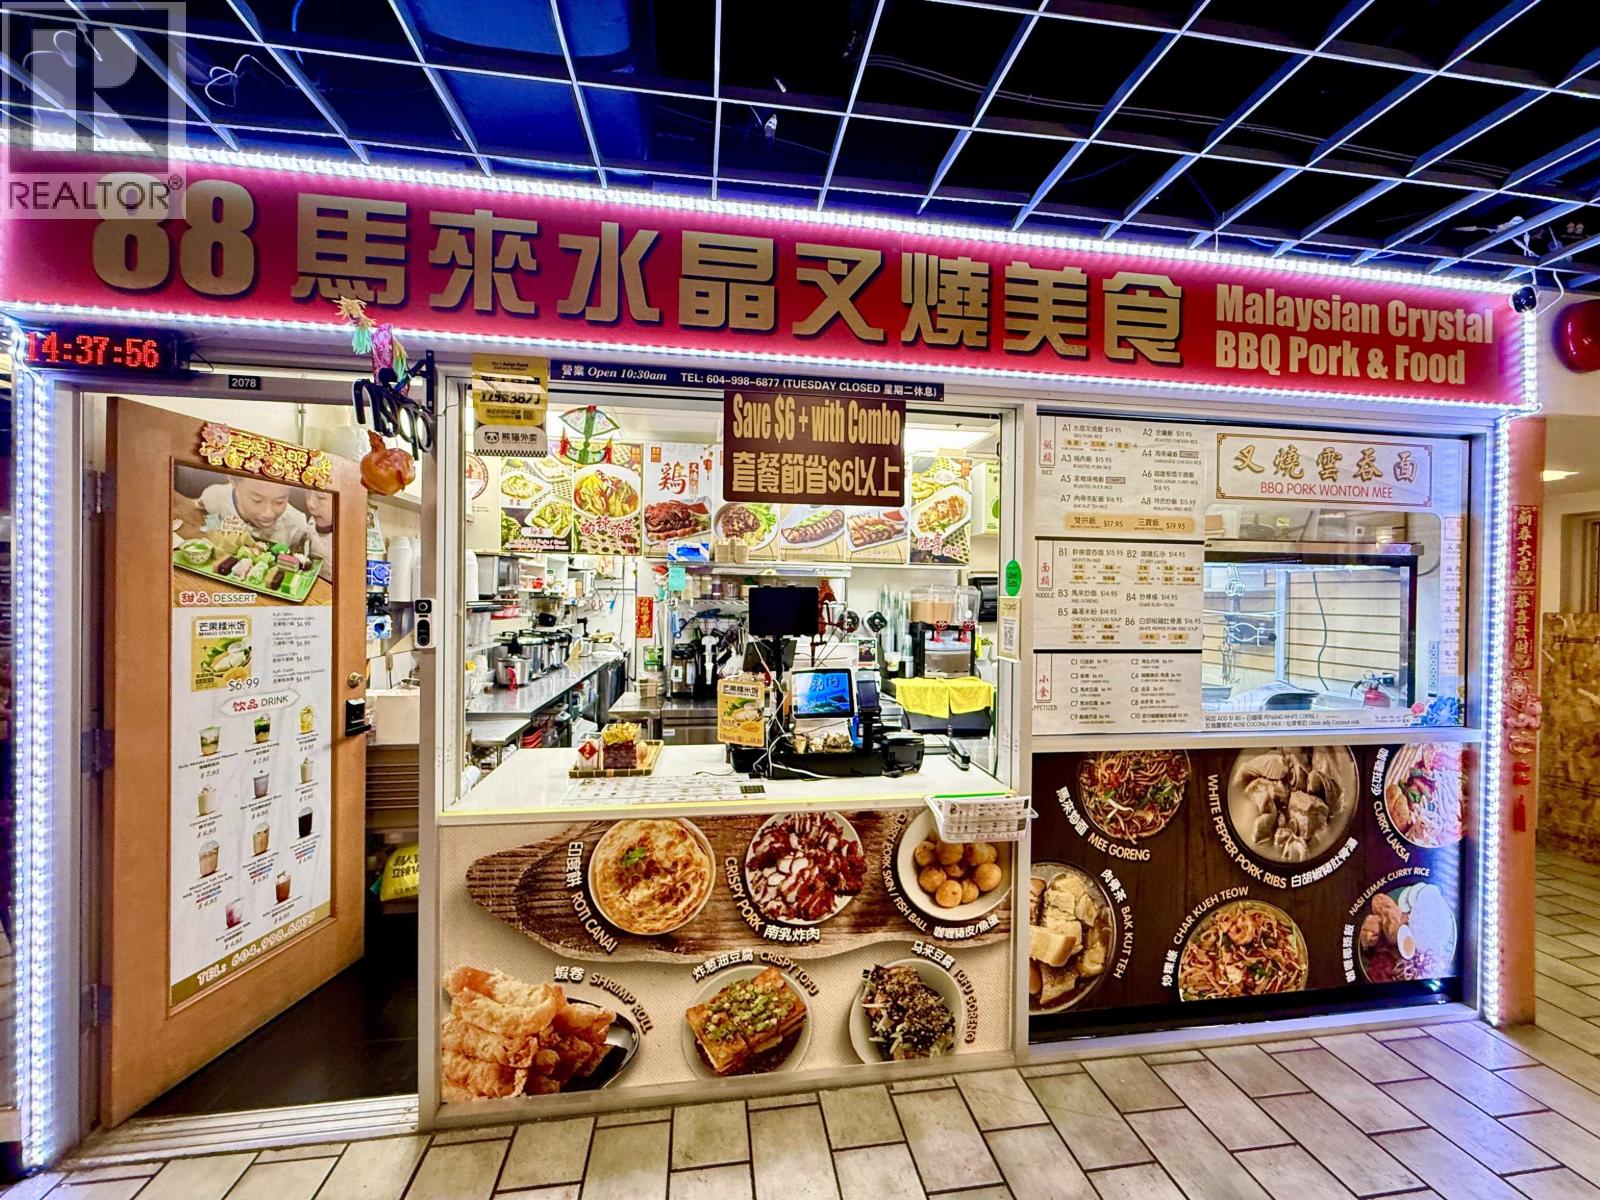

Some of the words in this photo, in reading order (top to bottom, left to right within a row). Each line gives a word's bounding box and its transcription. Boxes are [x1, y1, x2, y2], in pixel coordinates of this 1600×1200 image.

[92, 172, 255, 296] 88
[291, 192, 1182, 364] 馬來水晶叉燒美食
[1216, 283, 1380, 334] Malaysian
[1388, 300, 1494, 345] Crystal
[26, 331, 160, 369] 14:37:56
[1216, 331, 1281, 376] BBQ
[1289, 335, 1361, 378] Pork
[1366, 354, 1389, 380] &
[1397, 345, 1466, 386] Food
[231, 377, 257, 389] 2078
[588, 366, 617, 379] Open
[621, 369, 667, 381] 10:30am
[681, 372, 704, 385] TEL:
[782, 379, 837, 393] (TUESDAY
[839, 382, 881, 394] CLOSED
[732, 393, 772, 440] Save
[774, 393, 795, 444] $6
[798, 409, 809, 433] +
[811, 399, 845, 443] with
[848, 399, 901, 446] Combo
[1062, 424, 1071, 432] A1
[1143, 428, 1152, 436] A2
[732, 451, 901, 498] 套餐節省$6以上
[1061, 494, 1071, 502] A7
[1141, 497, 1151, 505] A8
[1260, 481, 1284, 494] BBQ
[1286, 483, 1316, 496] PORK
[1320, 484, 1370, 497] WONTON
[1372, 486, 1393, 499] MEE
[1059, 548, 1067, 556] B1
[1127, 550, 1136, 558] B2
[181, 593, 209, 603] 甜品
[213, 593, 256, 603] DESSERT
[1058, 589, 1068, 597] B3
[1126, 593, 1136, 601] B4
[1058, 608, 1068, 616] B5
[1125, 617, 1135, 626] B6
[228, 677, 260, 692] $6.99
[261, 695, 289, 708] DRINK
[1207, 774, 1221, 814] WHITE
[1213, 816, 1238, 857] PEPPER
[1373, 801, 1396, 834] CURRY
[1387, 832, 1410, 863] LAKSA
[881, 846, 894, 870] PORK
[1087, 832, 1108, 852] MEE
[1108, 843, 1151, 861] GORENG
[566, 841, 584, 887] 印度餅
[1235, 856, 1262, 879] PORK
[881, 869, 895, 890] SKIN
[1100, 868, 1127, 904] 肉骨茶
[1263, 872, 1287, 889] RIBS
[1349, 899, 1365, 916] NASI
[1364, 876, 1388, 899] LEMAK
[1387, 867, 1413, 883] CURRY
[1413, 866, 1432, 878] RICE
[571, 890, 591, 922] ROTI
[724, 857, 745, 899] CRISPY
[736, 899, 766, 931] PORK
[763, 924, 821, 942] 南乳炸肉
[893, 895, 909, 916] FISH
[907, 912, 928, 932] BALL
[1121, 906, 1134, 930] BAK
[1173, 915, 1196, 945] CHAR
[1193, 894, 1219, 920] KUEH
[1219, 886, 1249, 902] TEOW
[584, 917, 618, 953] CANAI
[1122, 932, 1134, 956] KUT
[759, 951, 798, 974] CRISPY
[794, 969, 820, 997] TOFU
[1113, 957, 1129, 979] TEH
[554, 964, 585, 981] 蝦卷
[589, 972, 635, 1006] SHRIMP
[630, 1003, 654, 1034] ROLL
[911, 940, 956, 969] 马来豆腐
[953, 970, 975, 996] TOFU
[964, 995, 979, 1045] GORENG
